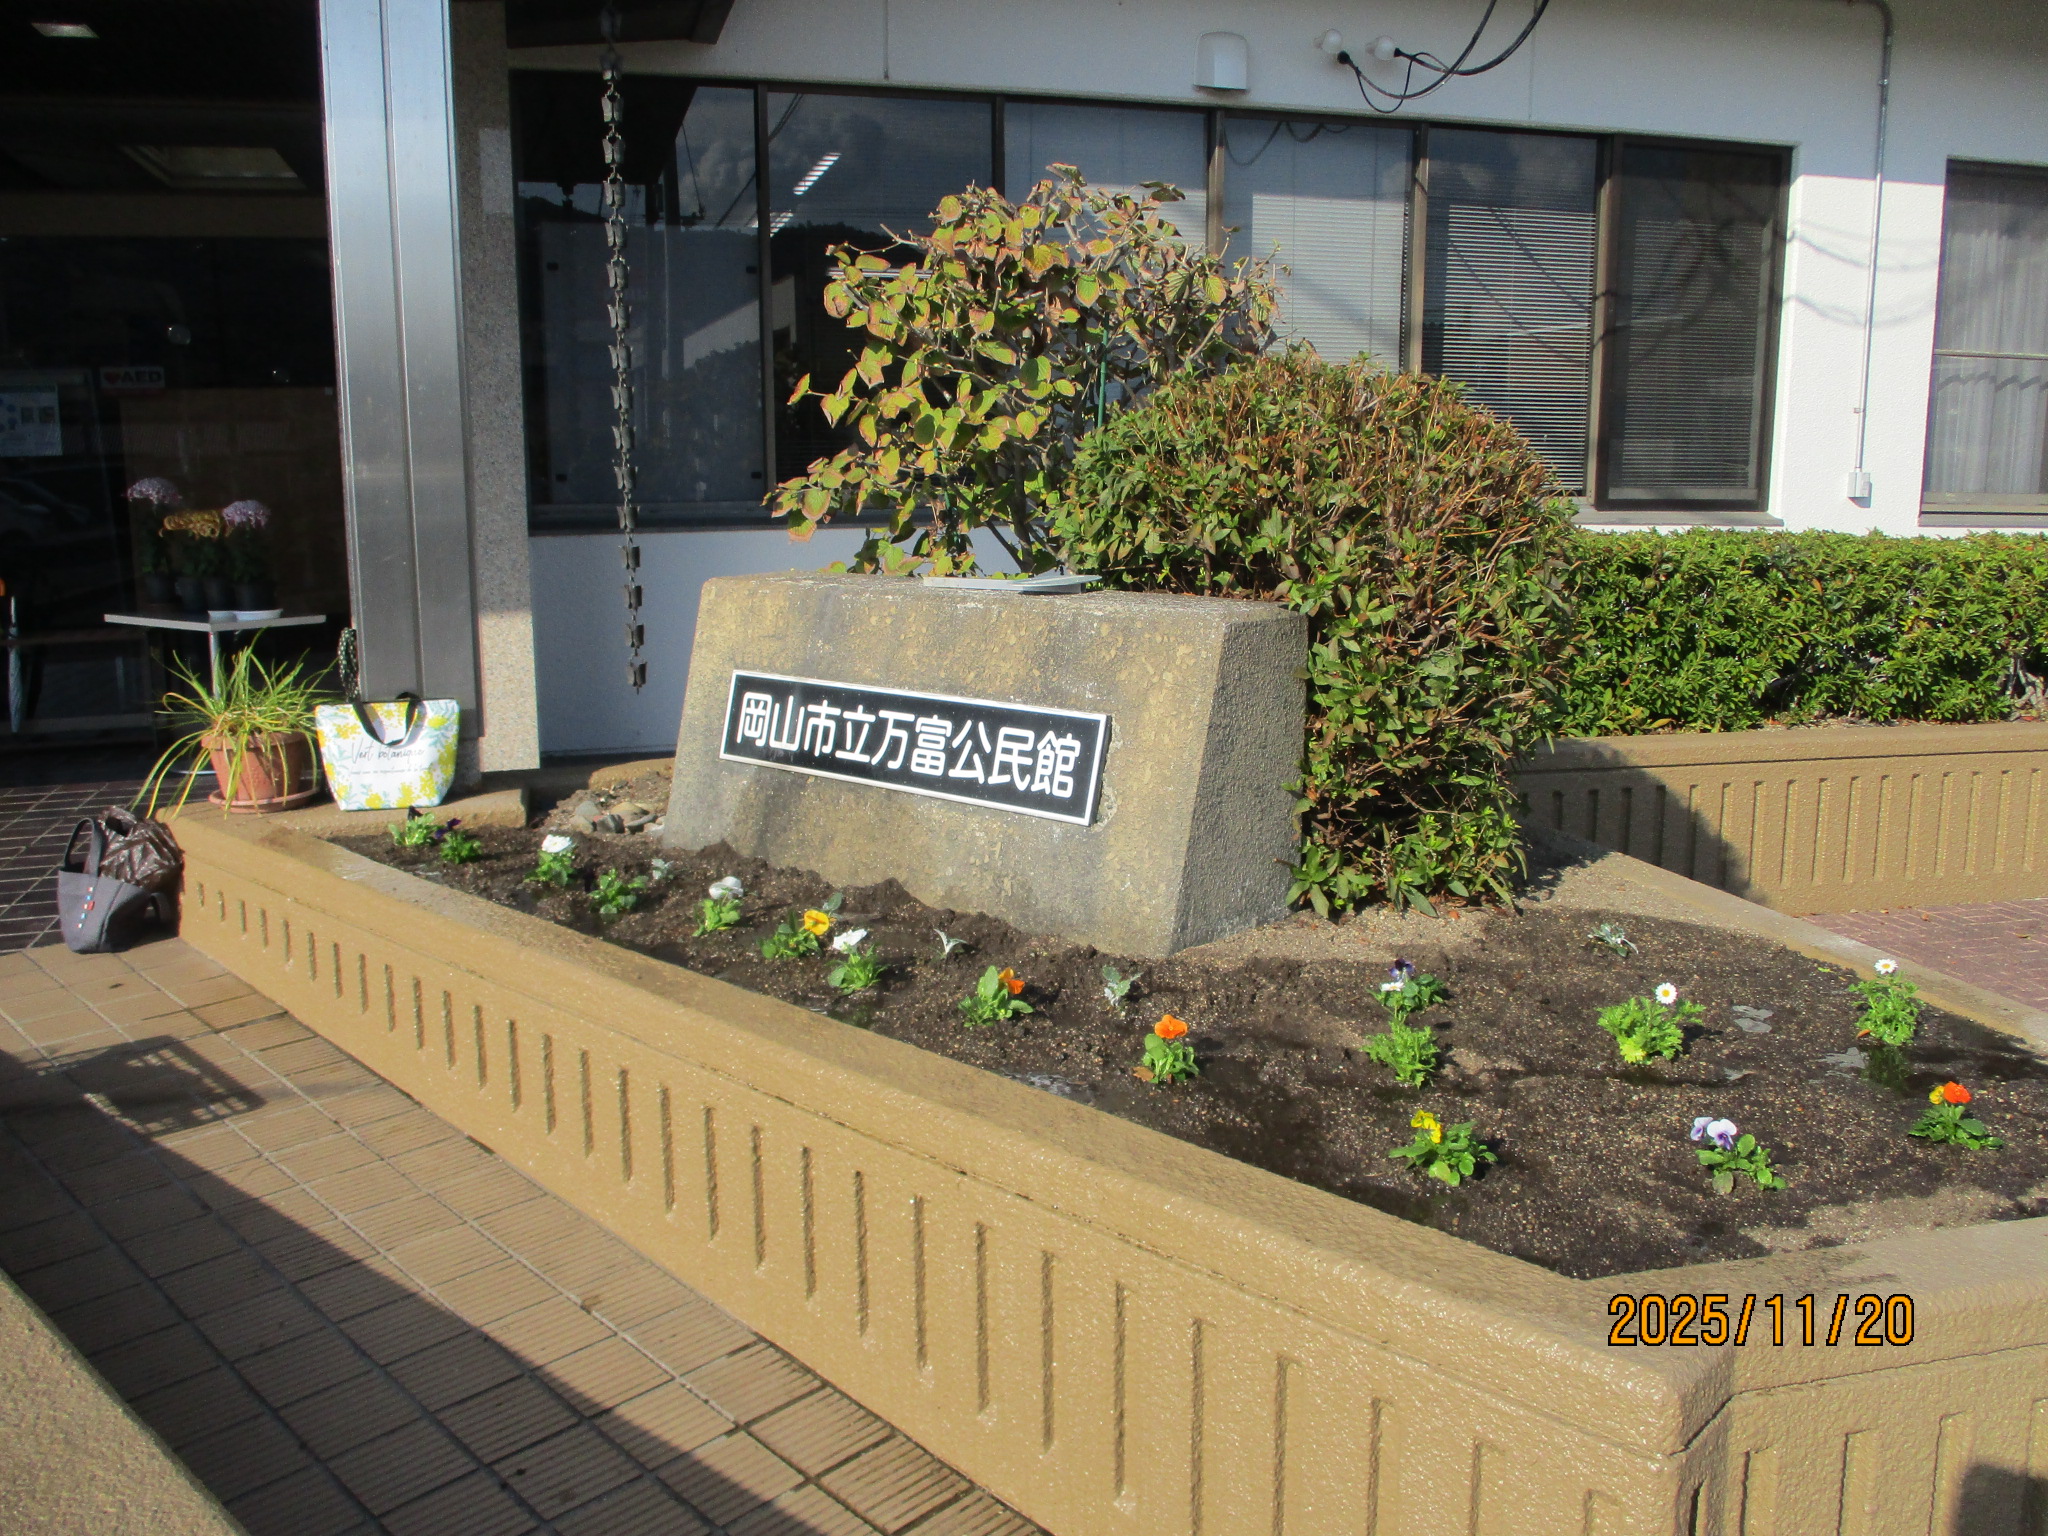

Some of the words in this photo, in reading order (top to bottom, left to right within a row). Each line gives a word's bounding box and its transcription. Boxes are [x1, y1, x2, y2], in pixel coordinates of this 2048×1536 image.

[121, 369, 162, 384] AED
[351, 738, 374, 763] Vert
[737, 691, 1081, 799] 岡山市立万富公民館
